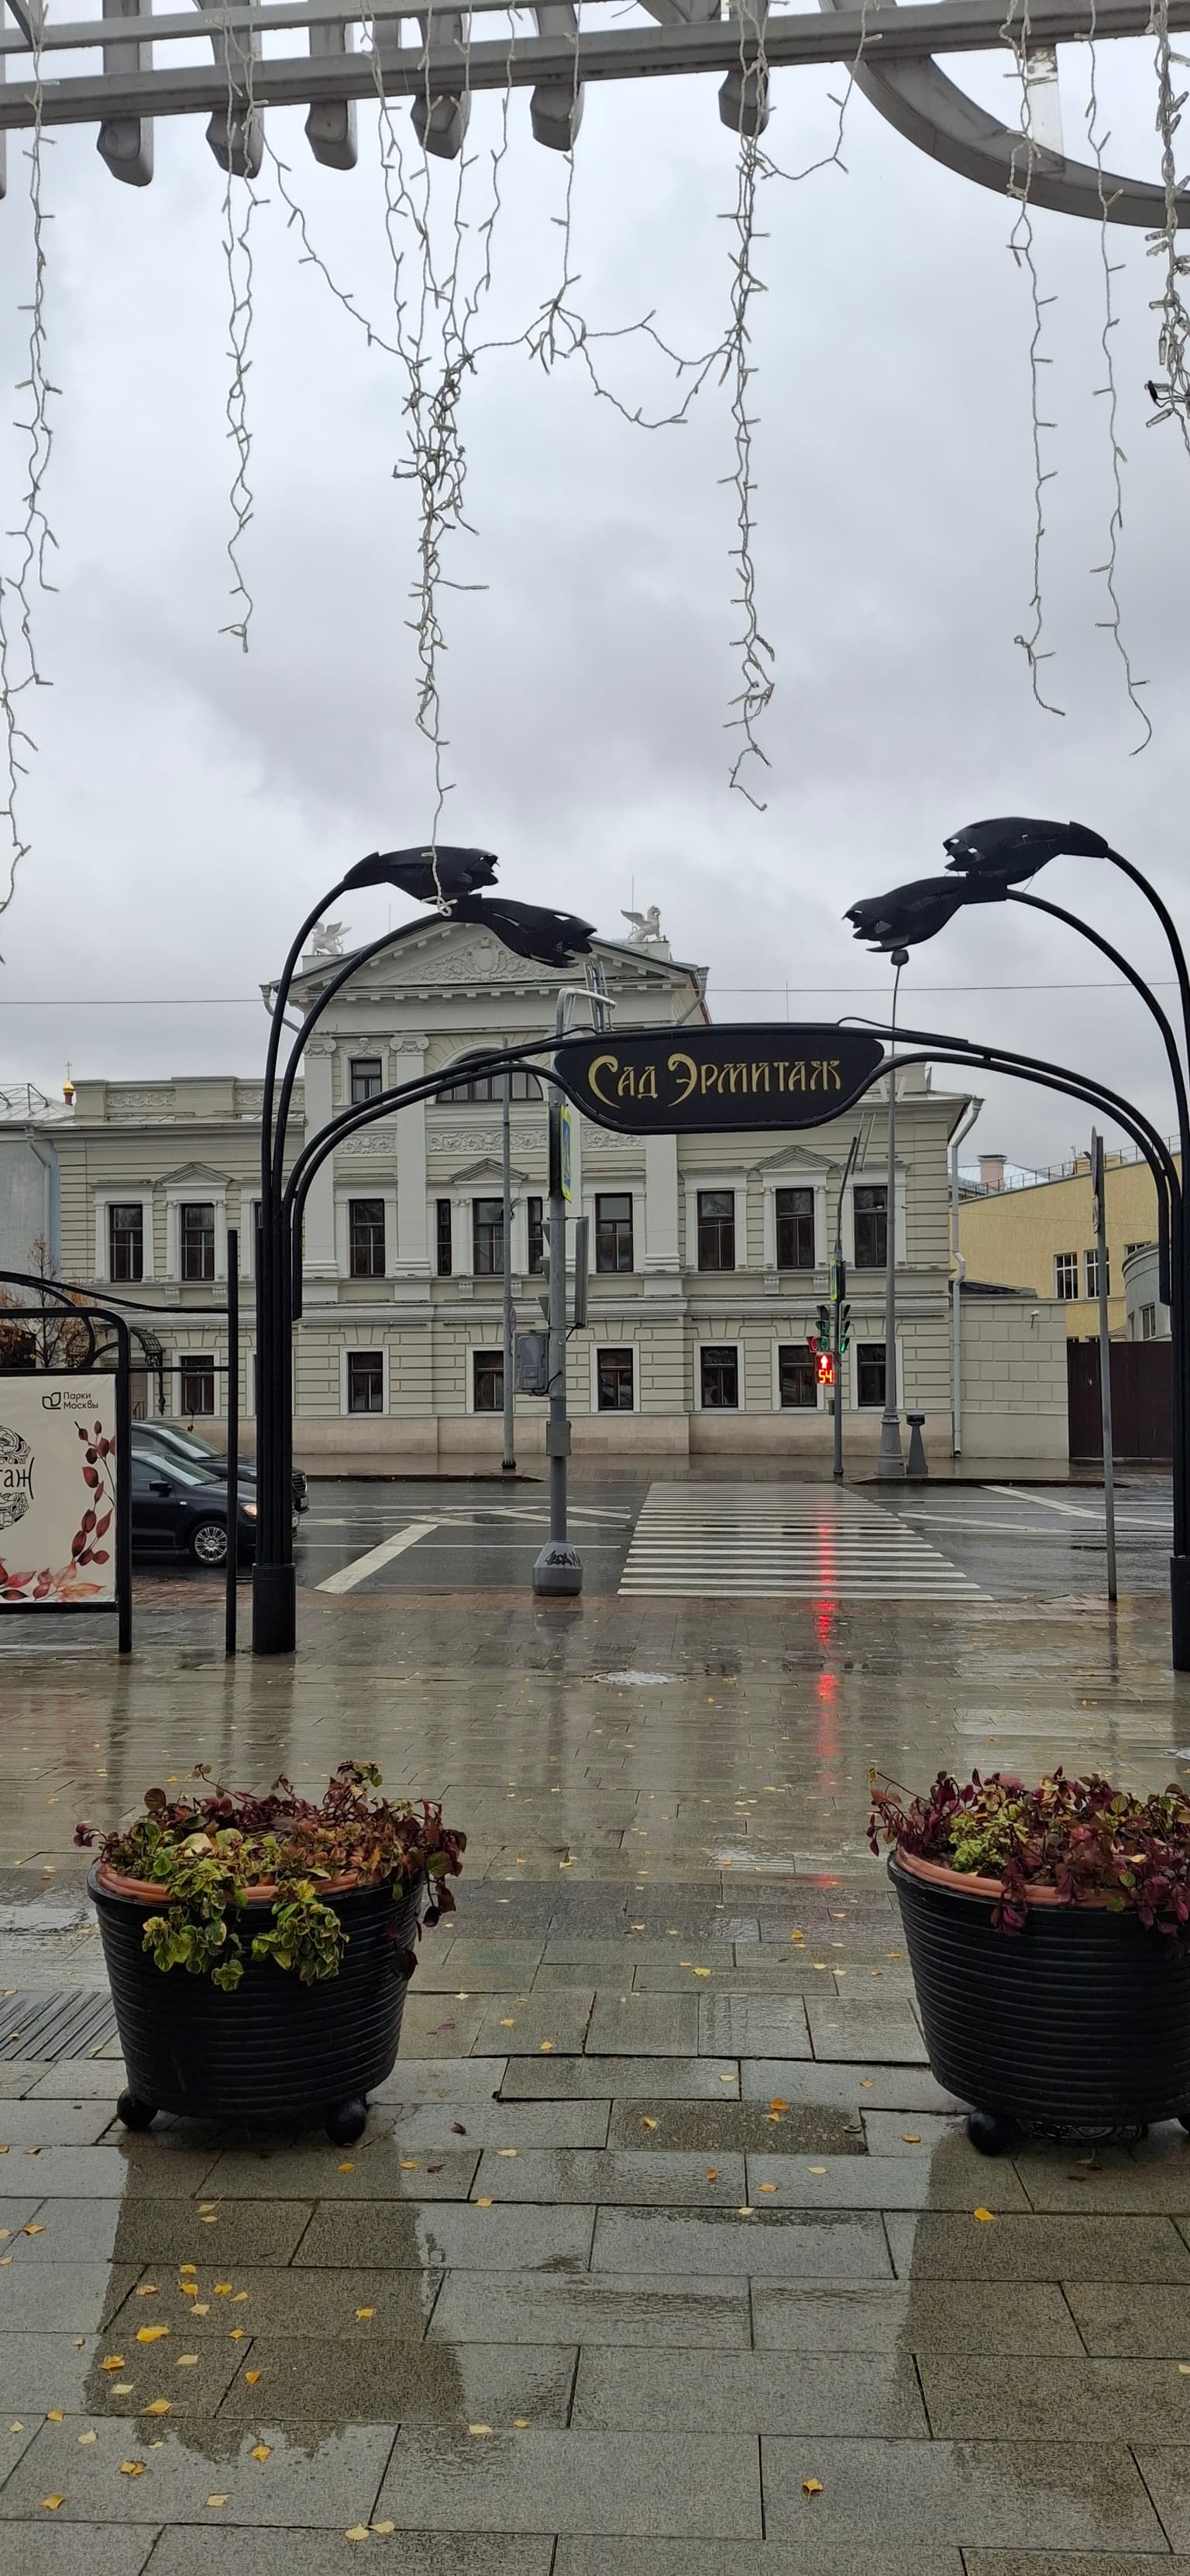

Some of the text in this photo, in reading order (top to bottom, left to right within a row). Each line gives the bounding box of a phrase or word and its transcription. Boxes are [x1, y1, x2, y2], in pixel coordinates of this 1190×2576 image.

[818, 1369, 833, 1383] 54
[63, 1392, 92, 1403] Парки
[63, 1400, 99, 1410] Москвы
